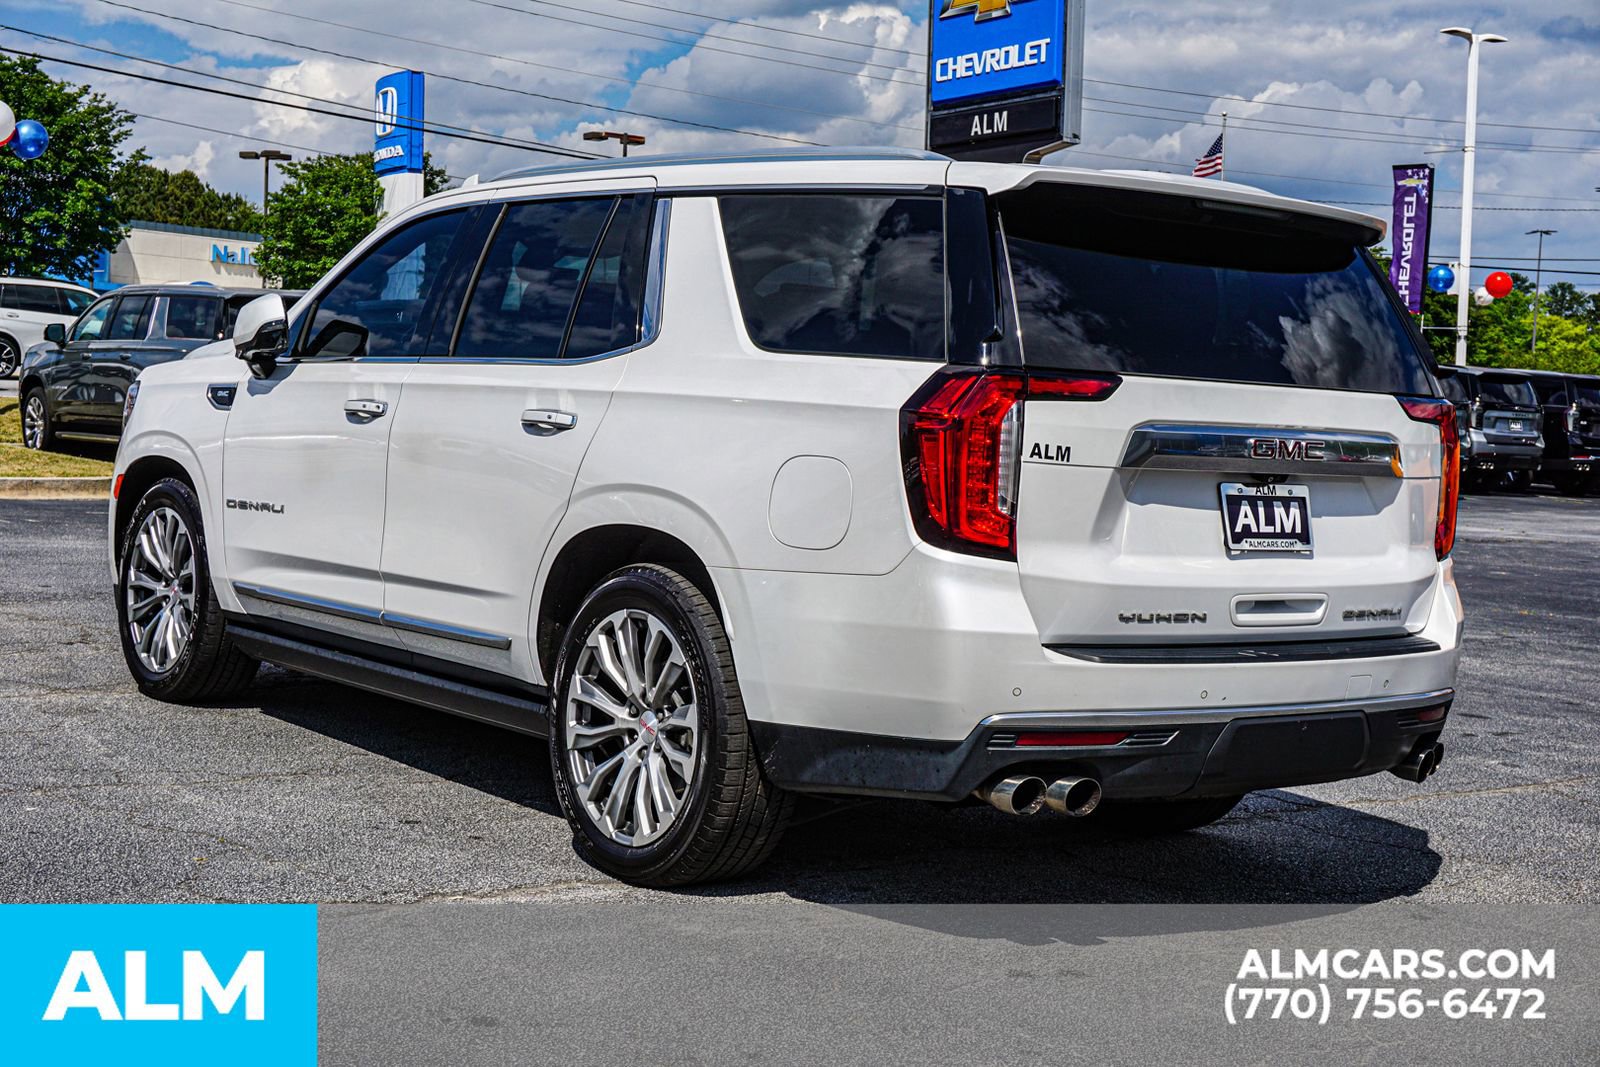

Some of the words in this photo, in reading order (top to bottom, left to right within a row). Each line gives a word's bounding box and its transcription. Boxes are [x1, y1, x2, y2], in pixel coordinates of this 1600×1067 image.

[936, 38, 1051, 82] CHEVROLET
[971, 111, 1008, 136] ALM
[374, 144, 405, 163] ONDA
[1029, 442, 1071, 463] ALM
[1251, 439, 1325, 461] GMC
[1255, 485, 1277, 496] ALM
[226, 499, 284, 514] DENALI
[1234, 500, 1302, 533] ALM
[1118, 612, 1208, 625] YUKON
